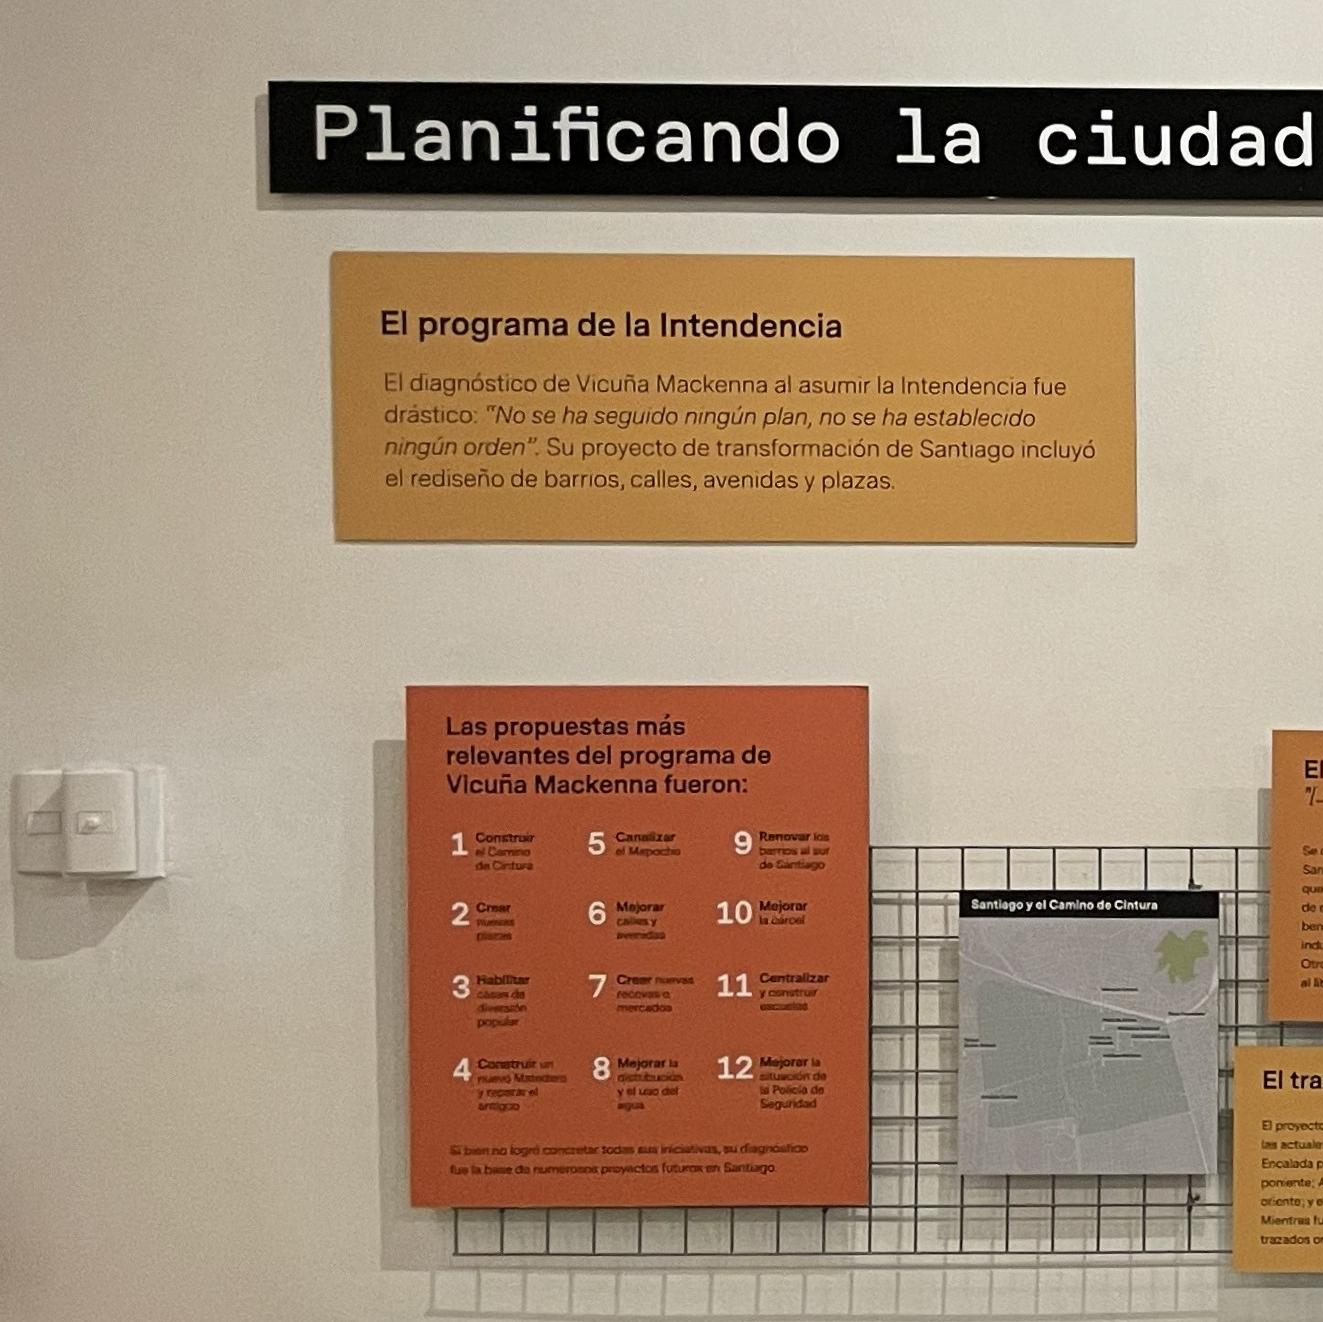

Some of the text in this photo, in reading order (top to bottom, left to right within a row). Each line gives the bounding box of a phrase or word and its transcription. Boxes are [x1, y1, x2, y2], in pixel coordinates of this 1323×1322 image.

[315, 103, 1313, 168] Planificando la ciudad
[380, 309, 842, 344] El programa de la Intendencia
[383, 371, 1067, 398] El diagnóstico de Vicuña Mackenna al asumir la Intendencia fue
[383, 403, 479, 425] drástico:
[531, 409, 557, 425] se
[561, 405, 589, 426] ha
[593, 405, 679, 430] seguido
[684, 404, 757, 431] ningún
[762, 406, 813, 430] plan,
[819, 411, 846, 426] no
[851, 411, 877, 427] se
[882, 407, 908, 427] ha
[913, 407, 1036, 428] establecido
[383, 435, 458, 462] ningún
[546, 436, 575, 457] Su
[581, 439, 677, 462] proyecto
[682, 437, 710, 457] de
[716, 437, 880, 458] transformación
[886, 439, 914, 459] de
[919, 438, 1015, 464] Santiago
[1021, 439, 1096, 463] incluyó
[385, 467, 895, 494] el rediseño de barrios, calles, avenidas y plazas.
[446, 713, 686, 742] Las propuestas más
[446, 744, 772, 770] relevantes del programa de
[446, 772, 748, 795] Vicuña Mackenna fueron:
[451, 831, 469, 857] 1
[475, 831, 536, 844] Construir
[588, 831, 606, 856] 5
[614, 831, 677, 843] Canalizar
[734, 830, 753, 855] 9
[758, 830, 812, 842] Renovar
[451, 901, 471, 926] 2
[475, 901, 512, 914] Crear
[588, 900, 607, 926] 6
[616, 900, 665, 915] Mejorar
[716, 899, 753, 925] 10
[759, 900, 808, 914] Mejorar
[971, 898, 1159, 913] Santiago y el Camino de Cintura
[452, 974, 471, 999] 3
[475, 974, 531, 986] Habilitar
[588, 974, 607, 999] 7
[616, 973, 653, 986] Crear
[717, 972, 753, 998] 11
[759, 972, 831, 984] Centralizar
[452, 1057, 473, 1082] 4
[477, 1058, 537, 1070] Construir
[592, 1056, 611, 1081] 8
[617, 1057, 667, 1072] Mejorar
[717, 1055, 754, 1080] 12
[759, 1055, 809, 1071] Mejorar
[1263, 1069, 1284, 1090] El
